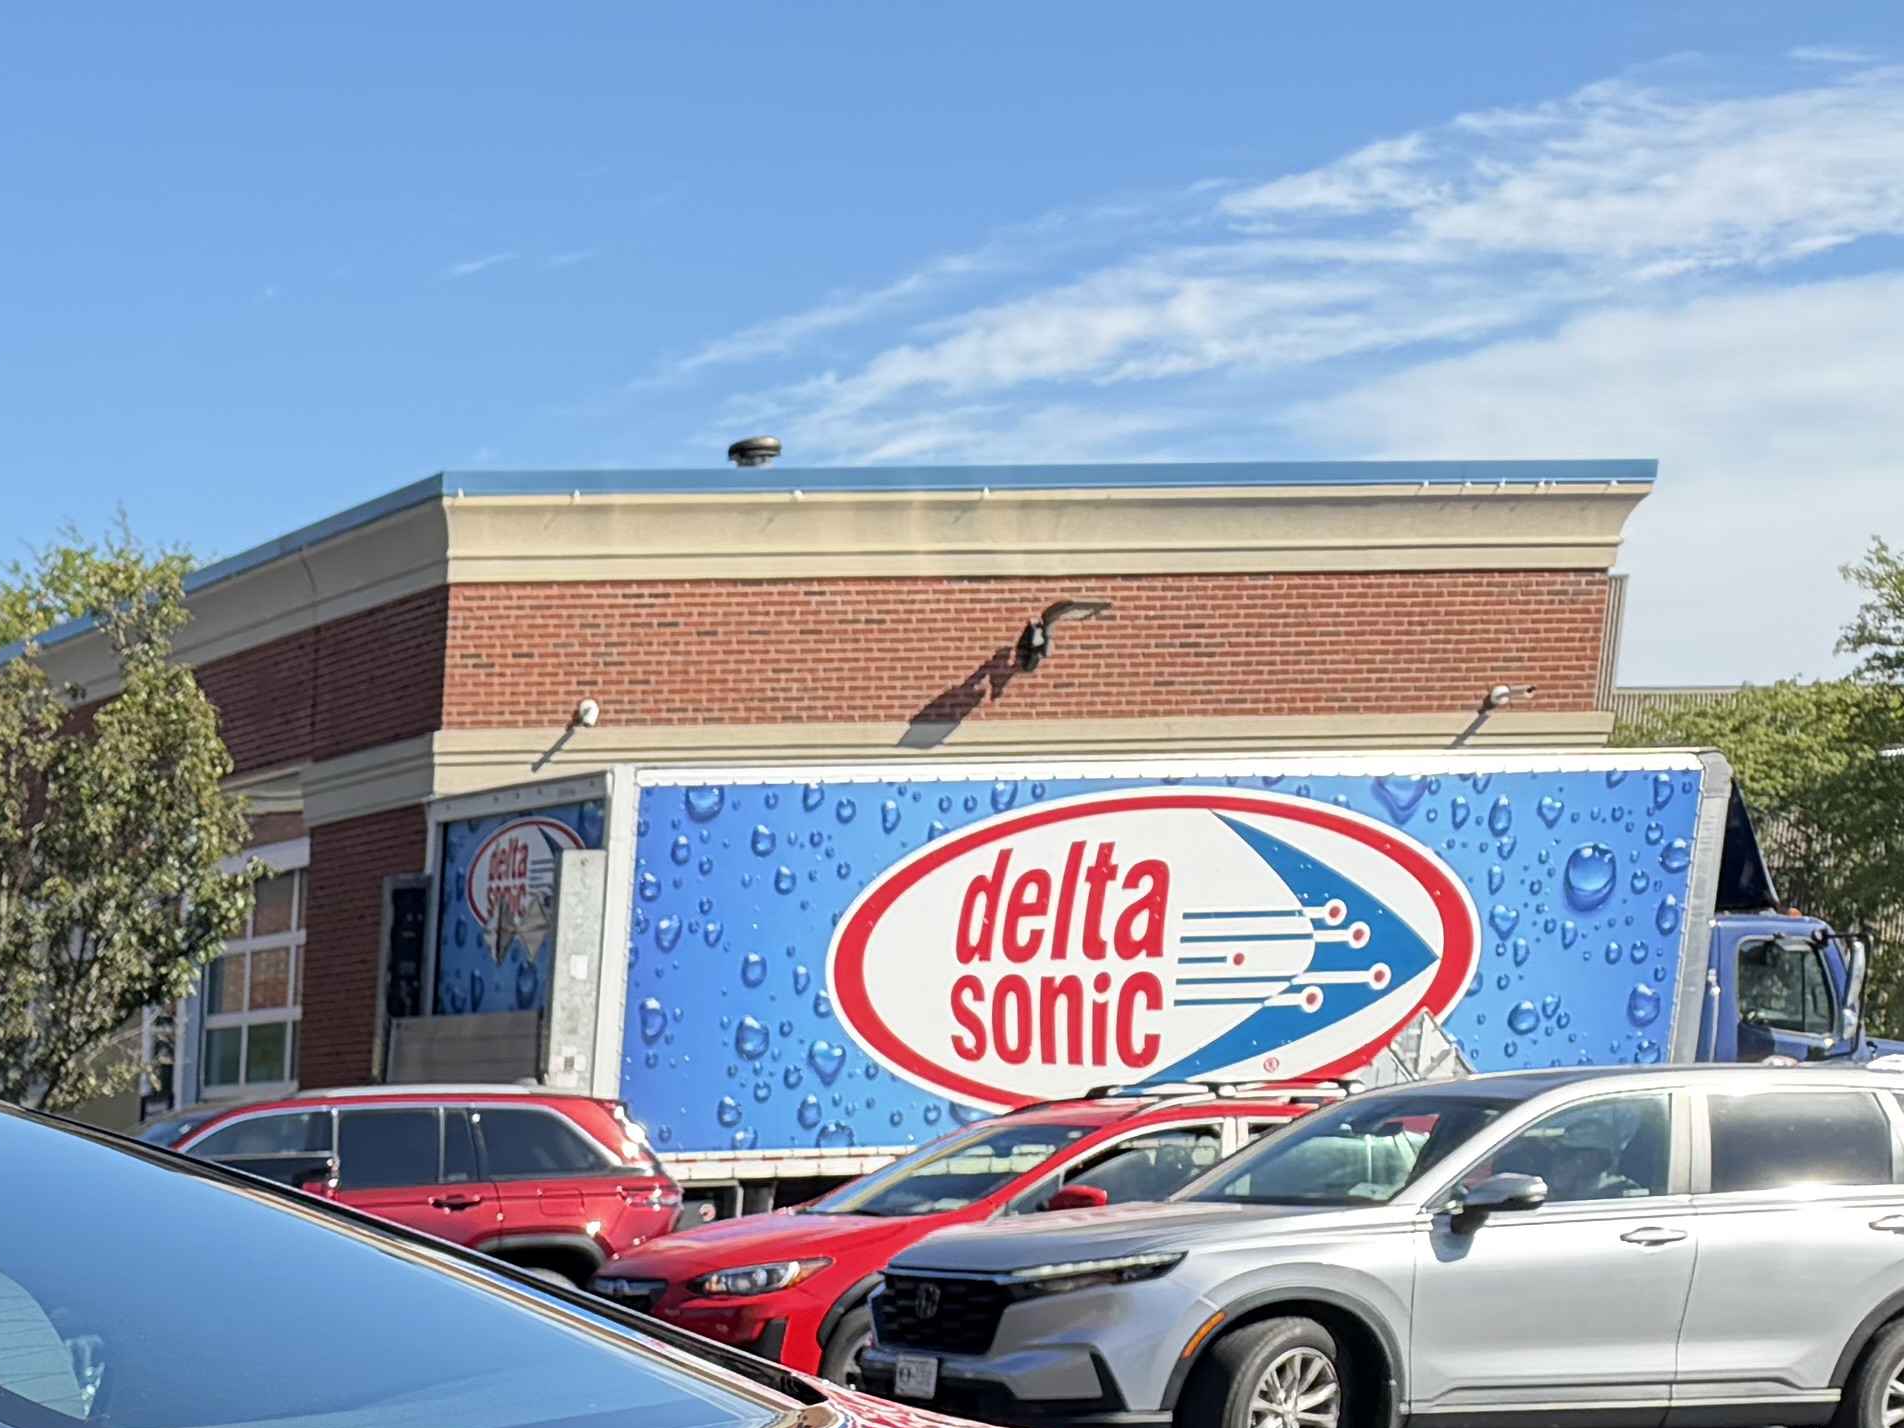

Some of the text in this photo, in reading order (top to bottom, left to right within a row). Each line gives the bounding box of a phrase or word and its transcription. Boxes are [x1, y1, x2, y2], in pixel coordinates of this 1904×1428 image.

[488, 836, 529, 880] delta
[956, 840, 1170, 964] delta
[950, 971, 1164, 1069] sonic
